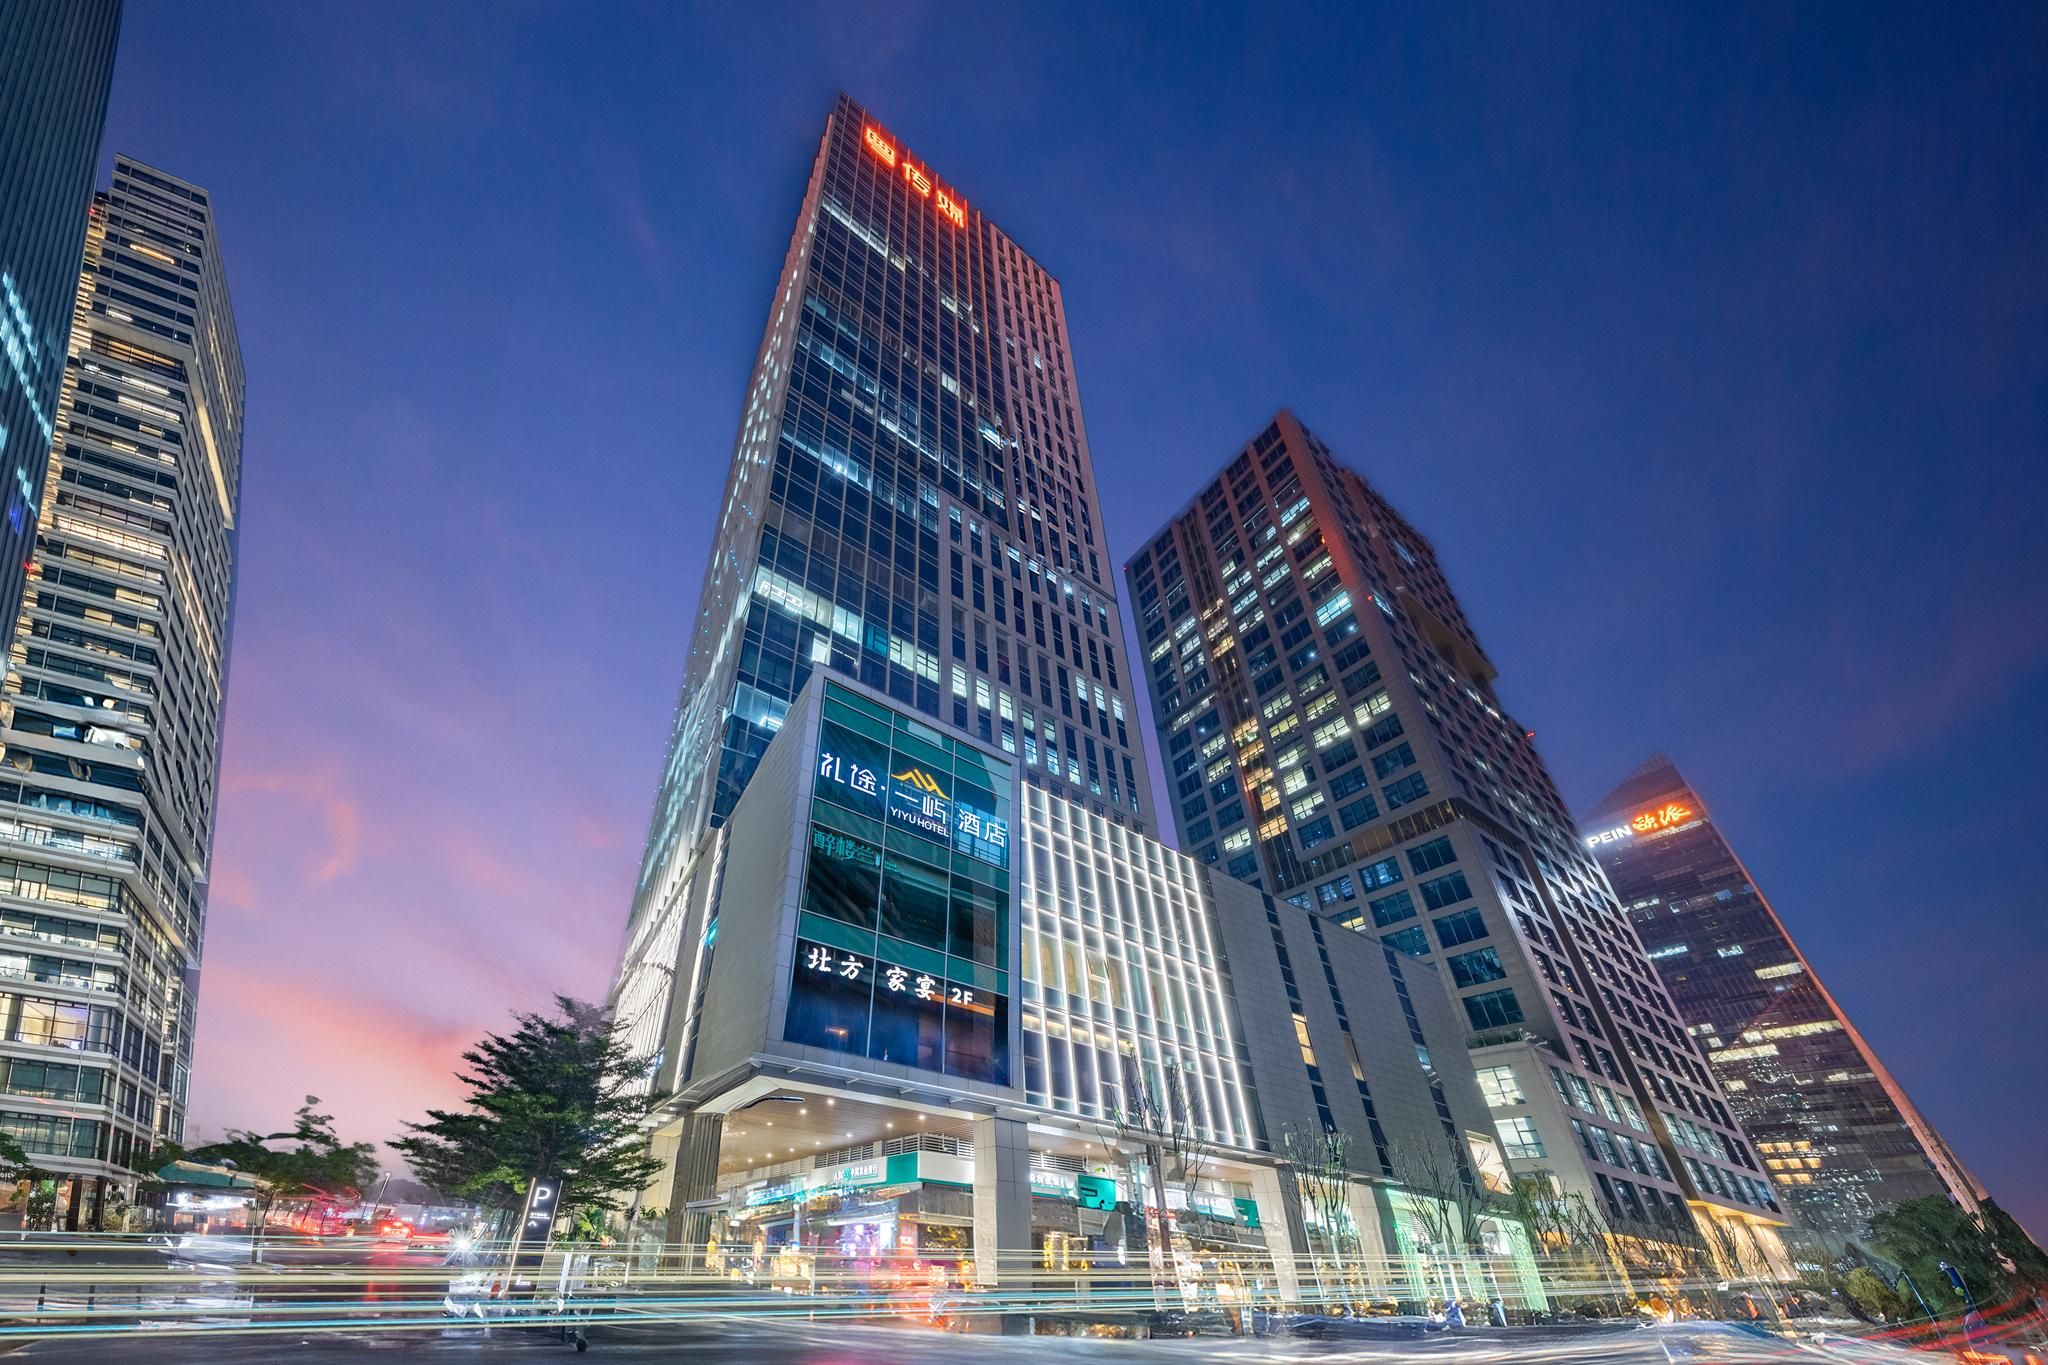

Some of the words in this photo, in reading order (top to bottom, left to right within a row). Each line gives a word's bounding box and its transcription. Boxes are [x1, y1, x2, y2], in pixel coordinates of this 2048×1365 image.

[890, 806, 917, 824] YIYU
[917, 817, 950, 838] HOTEL
[951, 987, 974, 1006] 2F
[532, 1186, 551, 1208] P
